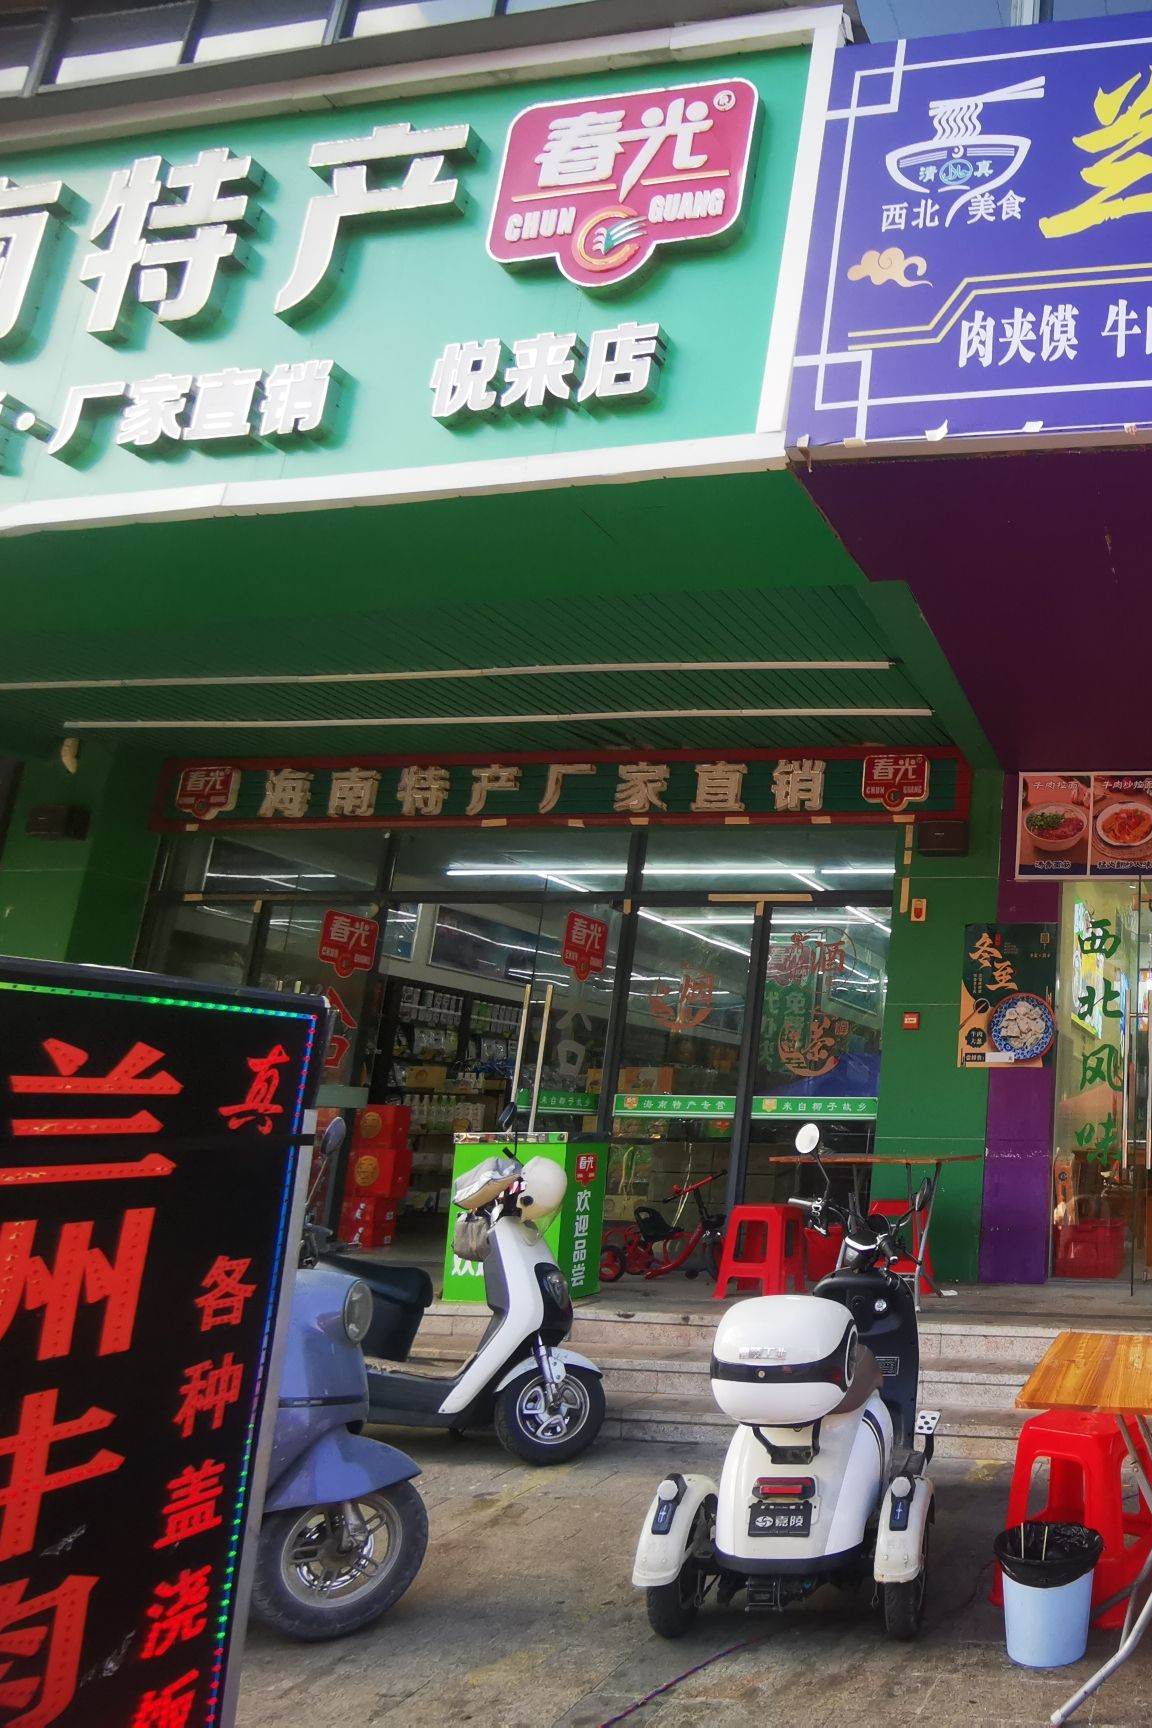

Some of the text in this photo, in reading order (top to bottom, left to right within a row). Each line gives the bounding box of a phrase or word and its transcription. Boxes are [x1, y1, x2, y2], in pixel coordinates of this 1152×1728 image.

[918, 159, 995, 183] 清真
[504, 188, 727, 244] CHUN GUANG
[958, 303, 1079, 369] 肉夹馍
[430, 322, 662, 419] 悦来店
[258, 760, 826, 817] 海南特产厂家直销
[872, 758, 917, 786] 春光
[329, 915, 370, 951] 春光
[571, 917, 602, 953] 春光
[968, 932, 1019, 991] 冬至
[1074, 918, 1124, 1166] 西北风味
[217, 1043, 291, 1135] 真
[643, 1099, 727, 1111] 海南特产专营
[782, 1101, 868, 1113] 来自椰子故乡
[570, 1189, 592, 1287] 欢迎品尝
[775, 1515, 804, 1528] 嘉陵
